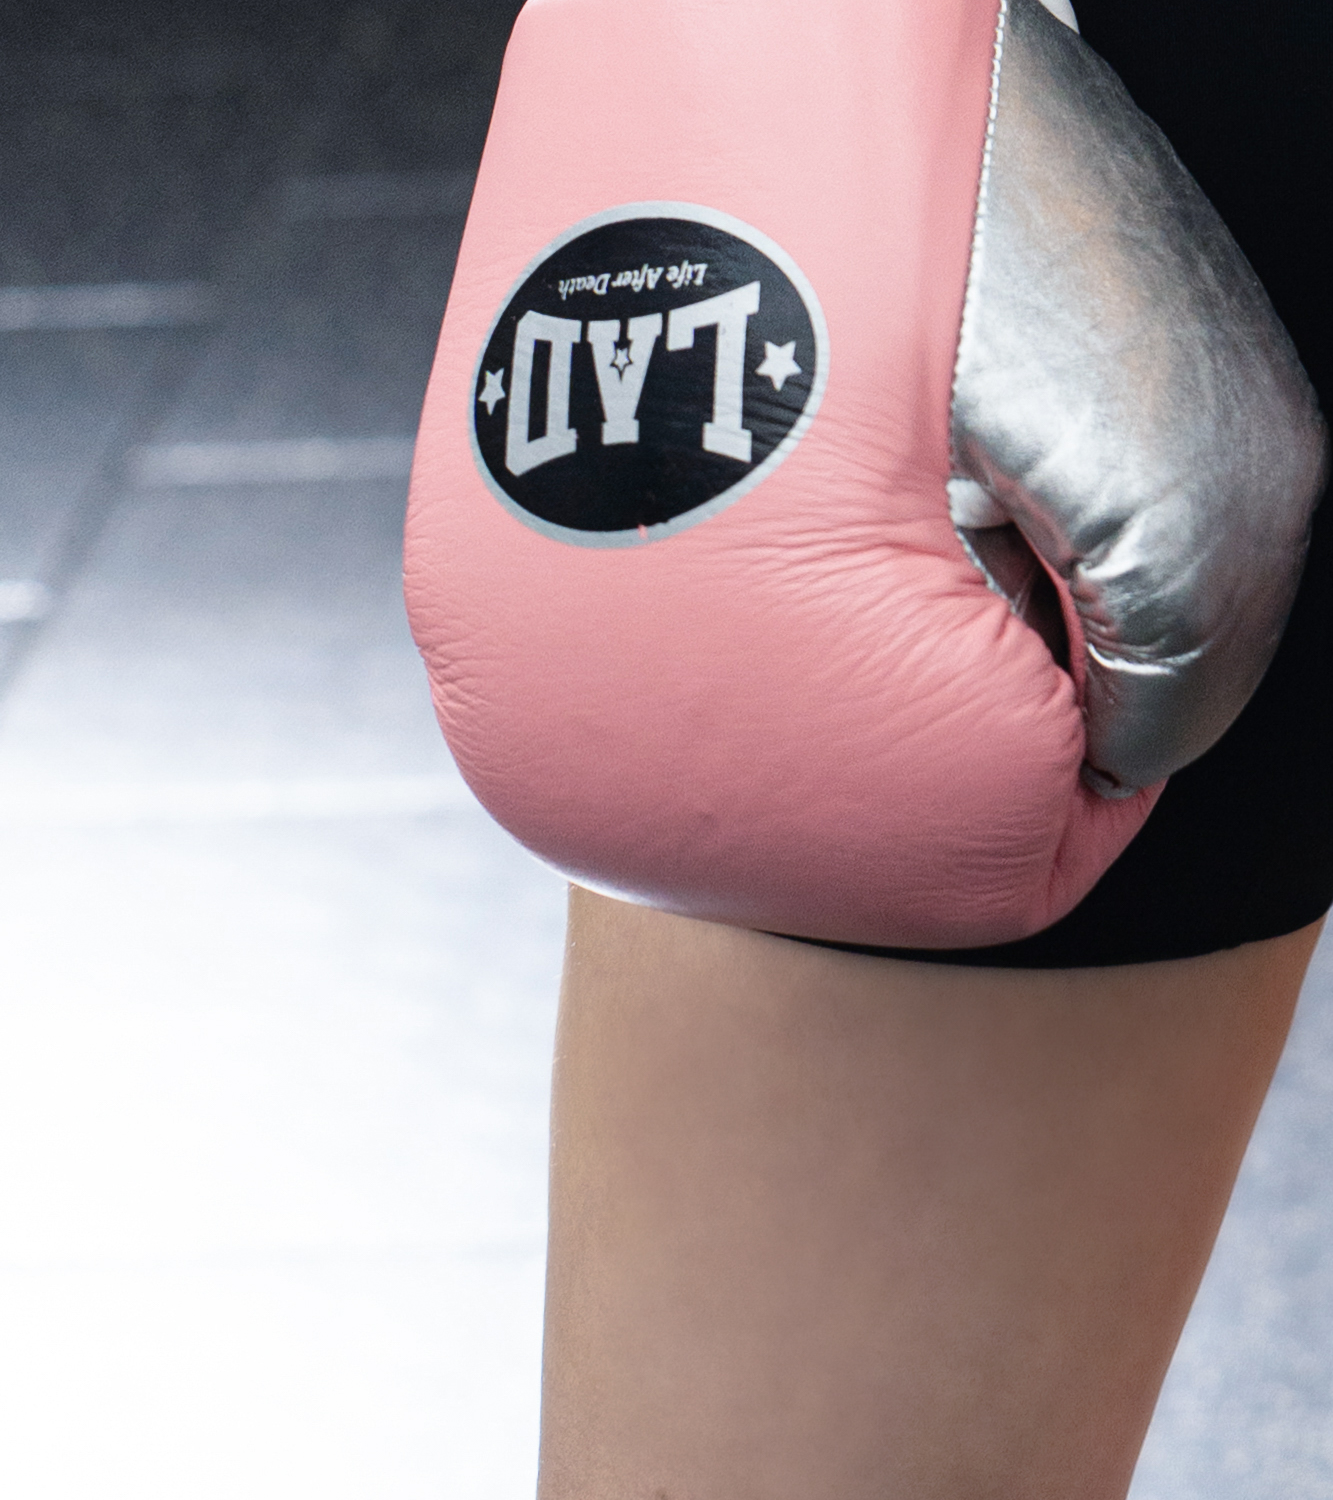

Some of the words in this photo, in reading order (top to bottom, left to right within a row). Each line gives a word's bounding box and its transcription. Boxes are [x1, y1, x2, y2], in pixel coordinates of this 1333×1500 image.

[558, 272, 611, 301] Death
[611, 263, 664, 293] After
[665, 259, 709, 290] Life
[504, 280, 761, 478] LAD
